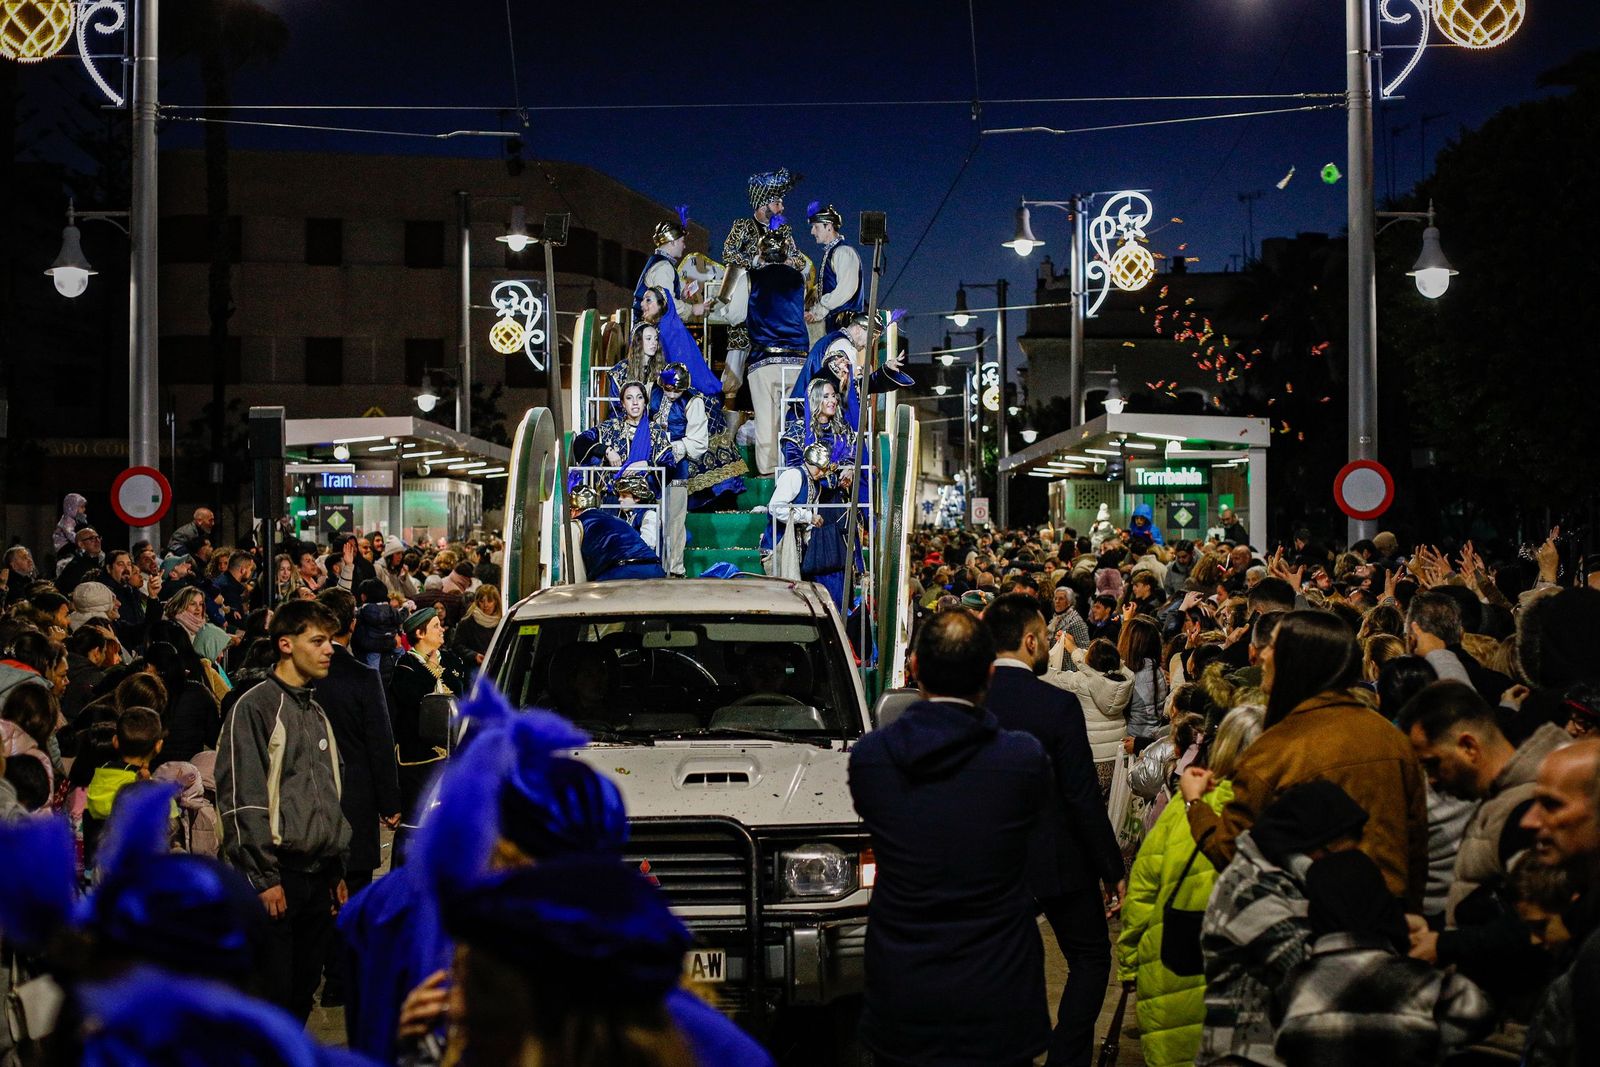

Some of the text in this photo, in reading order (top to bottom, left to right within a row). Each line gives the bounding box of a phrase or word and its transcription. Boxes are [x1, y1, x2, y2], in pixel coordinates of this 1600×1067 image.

[48, 440, 88, 457] ADO
[321, 472, 353, 488] Tram
[1135, 467, 1202, 485] Trambahía
